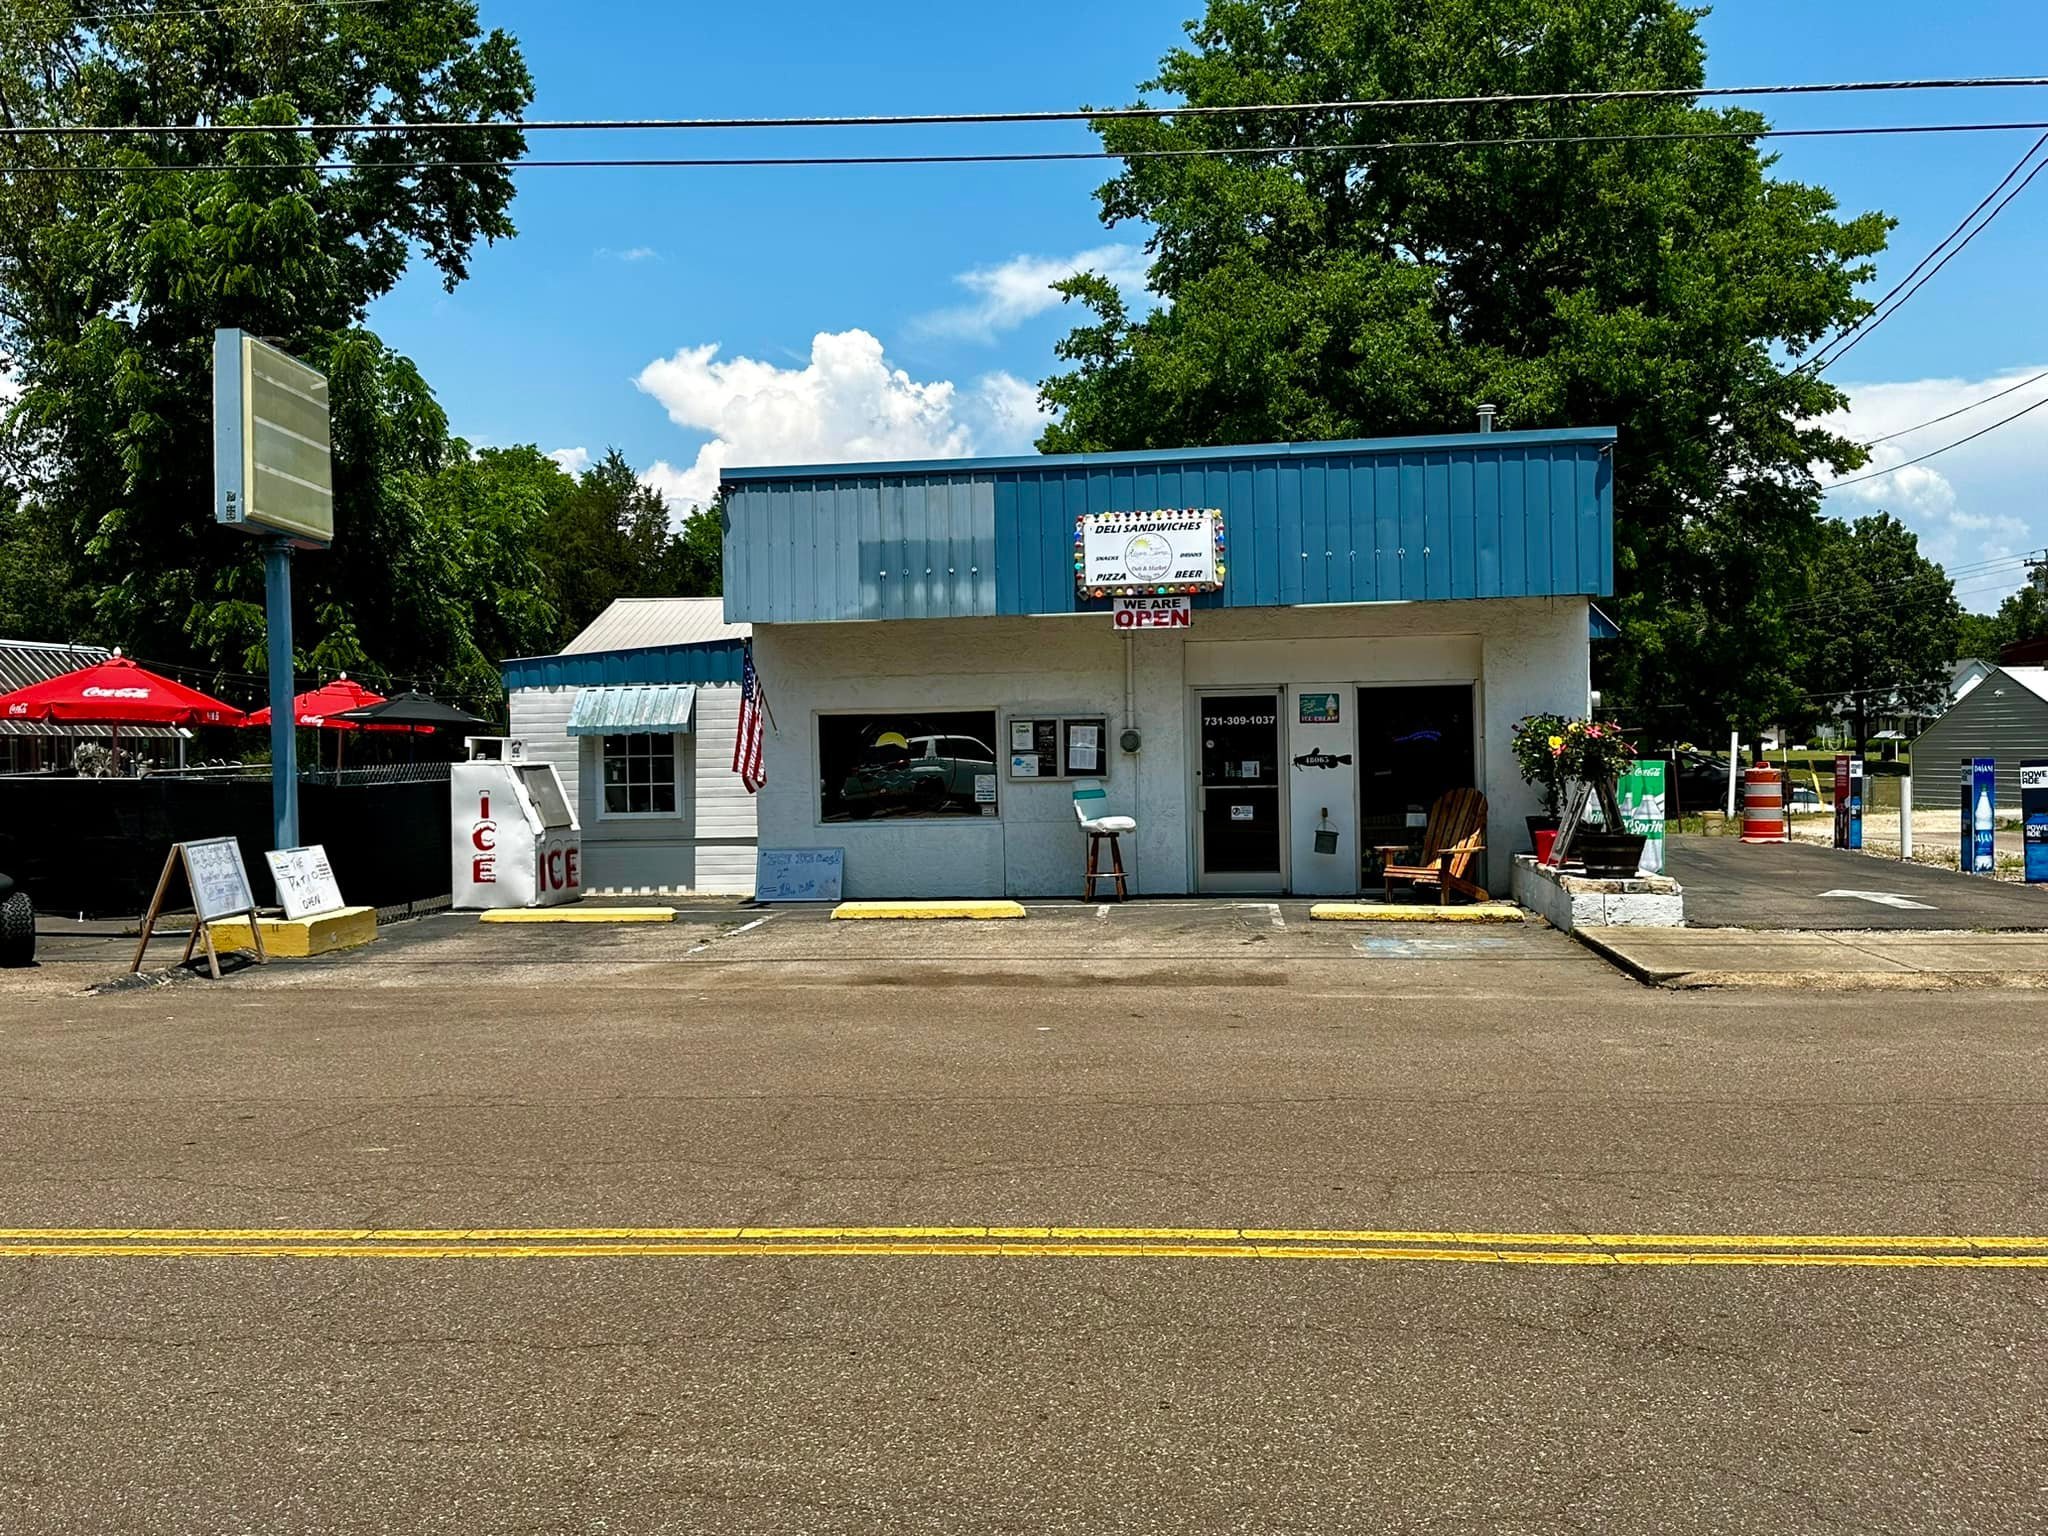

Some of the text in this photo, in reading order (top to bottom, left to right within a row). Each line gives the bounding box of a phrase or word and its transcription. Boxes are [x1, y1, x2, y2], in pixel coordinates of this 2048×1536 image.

[1095, 522, 1201, 534] DELI SANDWICHES
[1096, 573, 1126, 582] PIZZA
[1174, 570, 1203, 579] BEER
[1124, 599, 1181, 609] WE ARE
[1115, 609, 1189, 627] OPEN
[1203, 715, 1275, 726] 731-309-1037
[2022, 770, 2047, 778] POWE
[1632, 820, 1663, 834] Sprite
[472, 790, 497, 883] ICE
[539, 842, 579, 892] ICE
